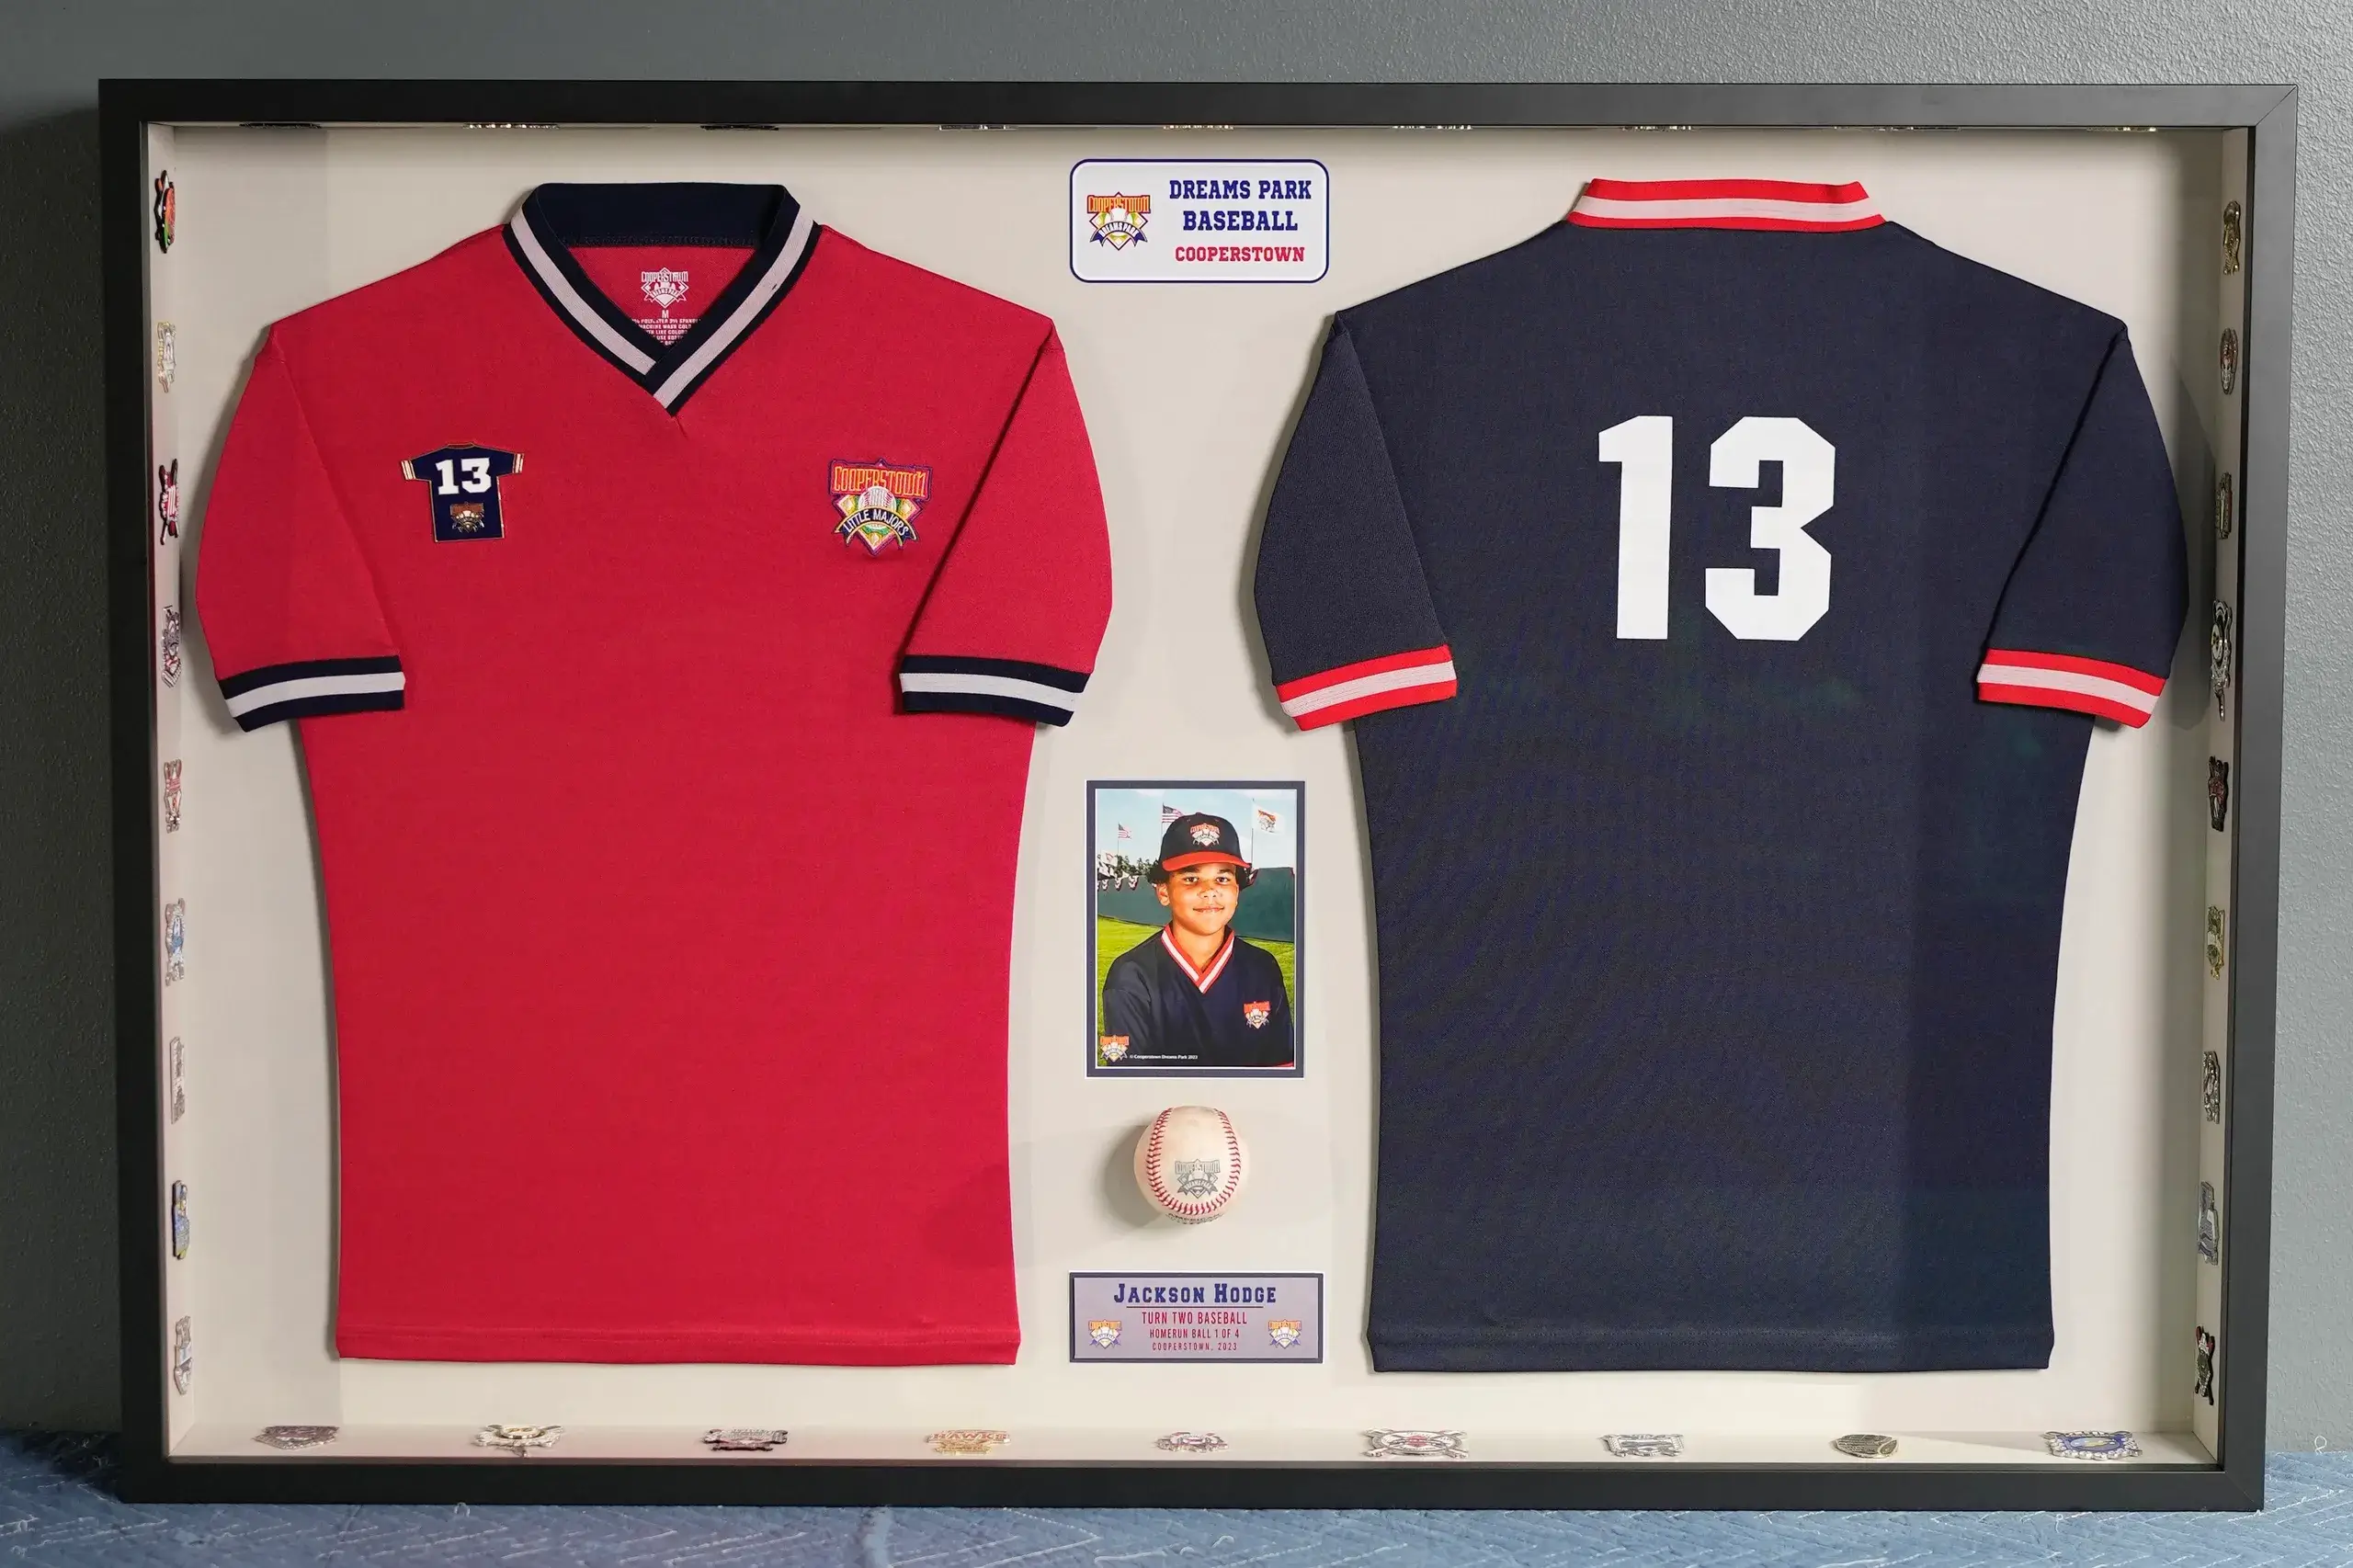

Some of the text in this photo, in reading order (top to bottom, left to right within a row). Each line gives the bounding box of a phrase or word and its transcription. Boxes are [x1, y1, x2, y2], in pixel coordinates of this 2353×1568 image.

[1169, 180, 1312, 199] DREAMS PARK
[1183, 210, 1299, 231] BASEBALL
[1175, 246, 1305, 262] COOPERSTOWN
[662, 310, 669, 318] M
[436, 458, 492, 494] 13
[834, 466, 926, 497] COOPERSTOWN
[842, 509, 909, 536] LITTLE MAJORS
[1598, 415, 1836, 642] 13
[1113, 1283, 1277, 1303] JACKSON HODGE
[1142, 1312, 1247, 1324] TURN TWO BASEBALL
[1150, 1328, 1240, 1339] HOMERUN BALL 1 OF 4
[1152, 1342, 1237, 1351] COOPERSTOWN, 2023
